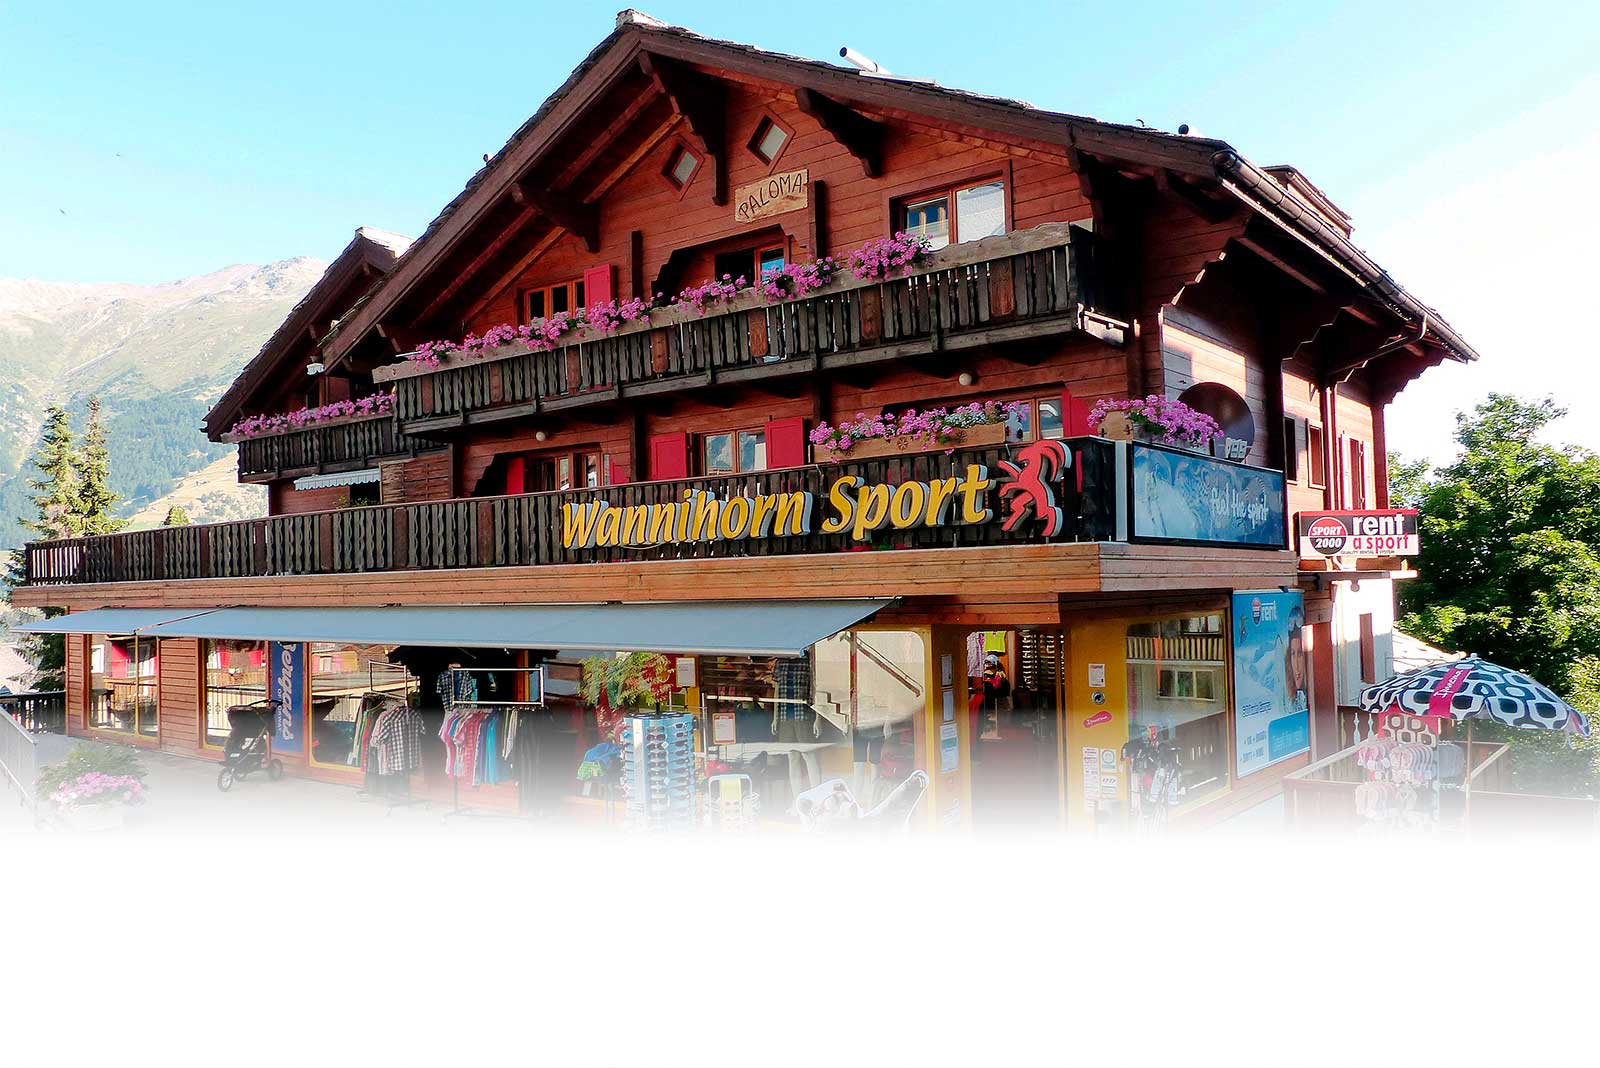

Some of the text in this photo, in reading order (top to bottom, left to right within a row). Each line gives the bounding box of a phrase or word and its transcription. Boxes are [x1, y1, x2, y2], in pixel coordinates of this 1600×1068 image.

[738, 173, 803, 219] PALOMA
[562, 464, 994, 549] Wannihorn Sport
[1247, 495, 1269, 529] spirit
[1312, 526, 1342, 536] SPORT
[1352, 513, 1405, 536] rent
[1315, 538, 1342, 549] 2000
[1353, 533, 1409, 554] a sport
[1261, 600, 1277, 622] rent
